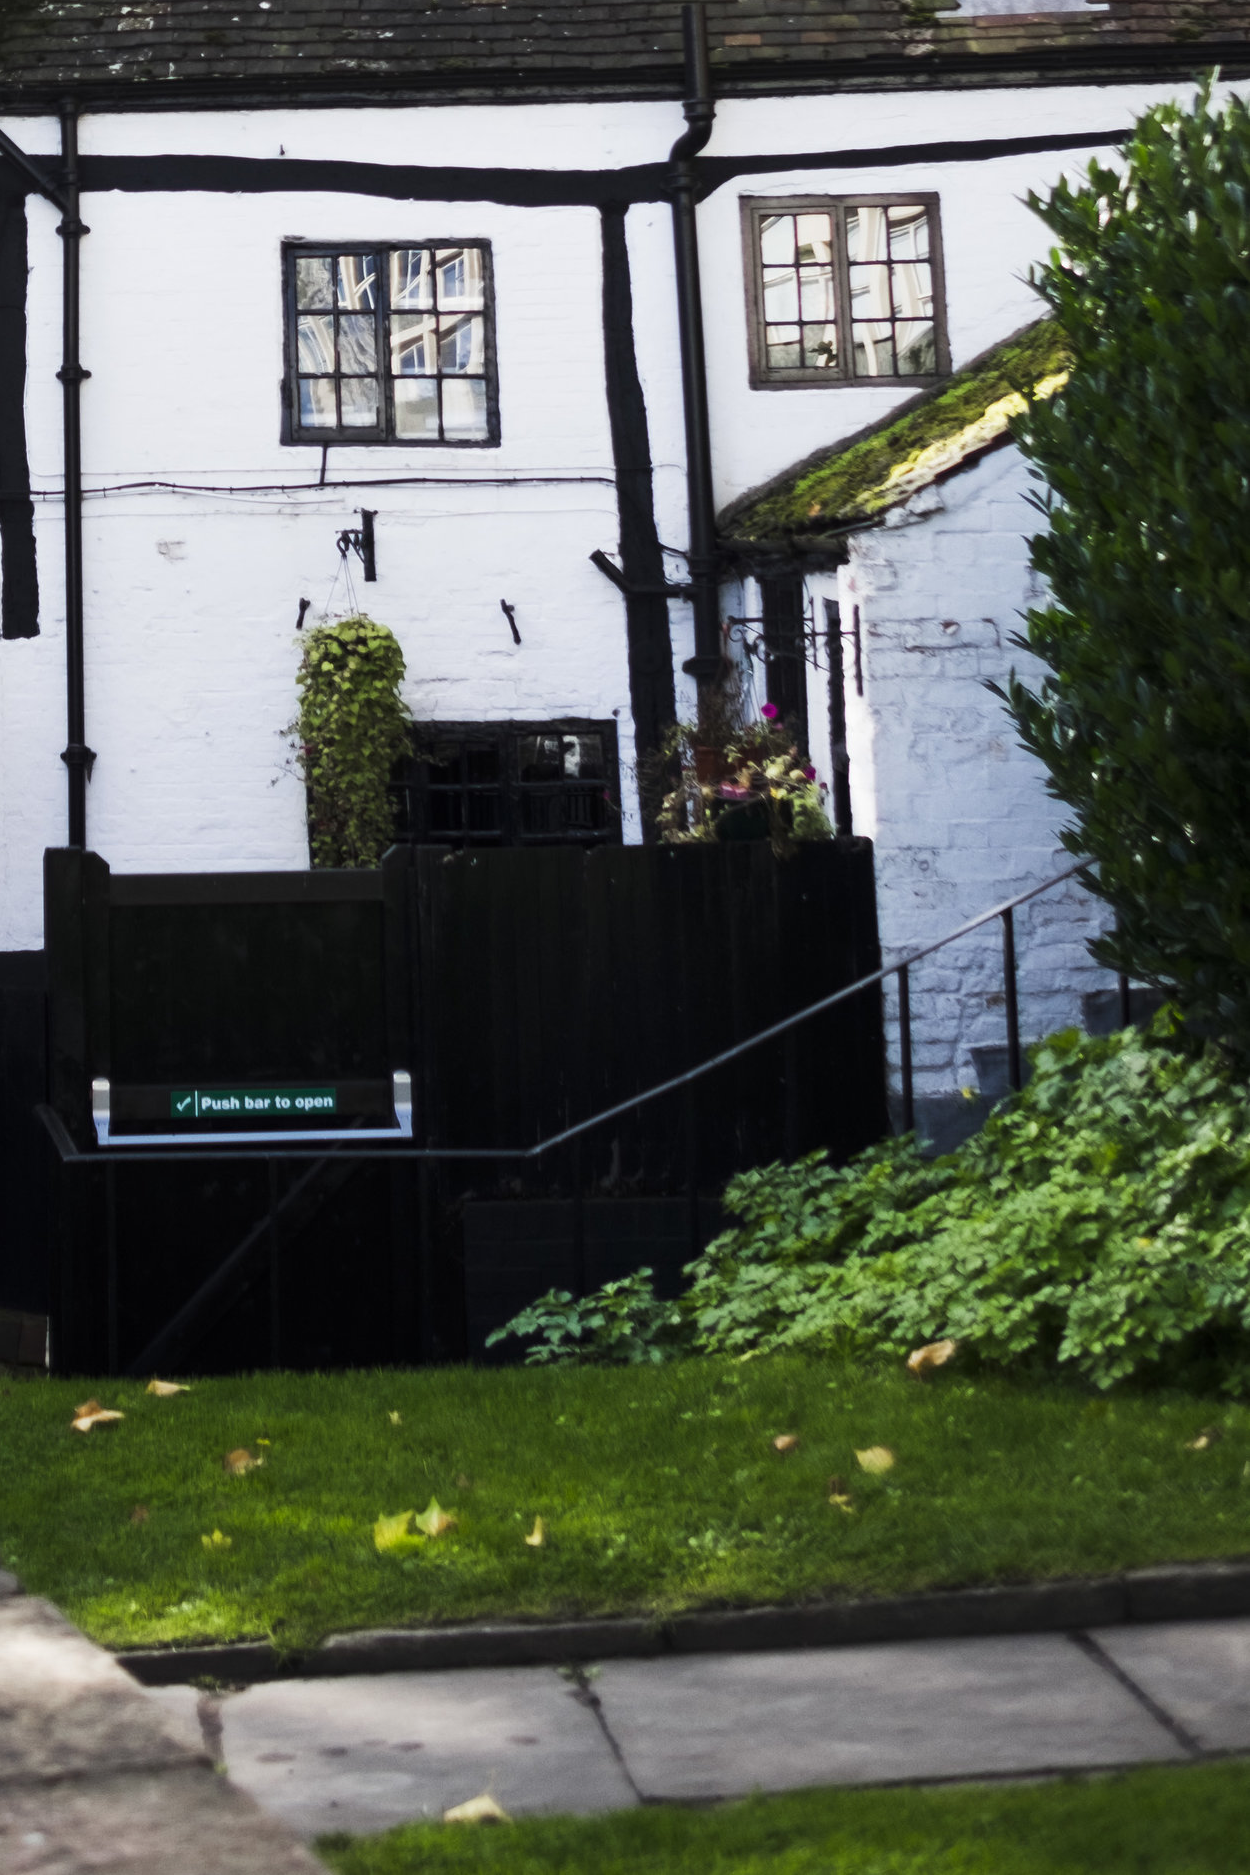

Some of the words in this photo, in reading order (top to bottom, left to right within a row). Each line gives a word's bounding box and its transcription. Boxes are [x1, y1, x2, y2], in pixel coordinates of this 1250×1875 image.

[200, 1095, 241, 1111] Push
[243, 1095, 271, 1110] bar
[274, 1095, 292, 1110] to
[294, 1095, 335, 1112] open
